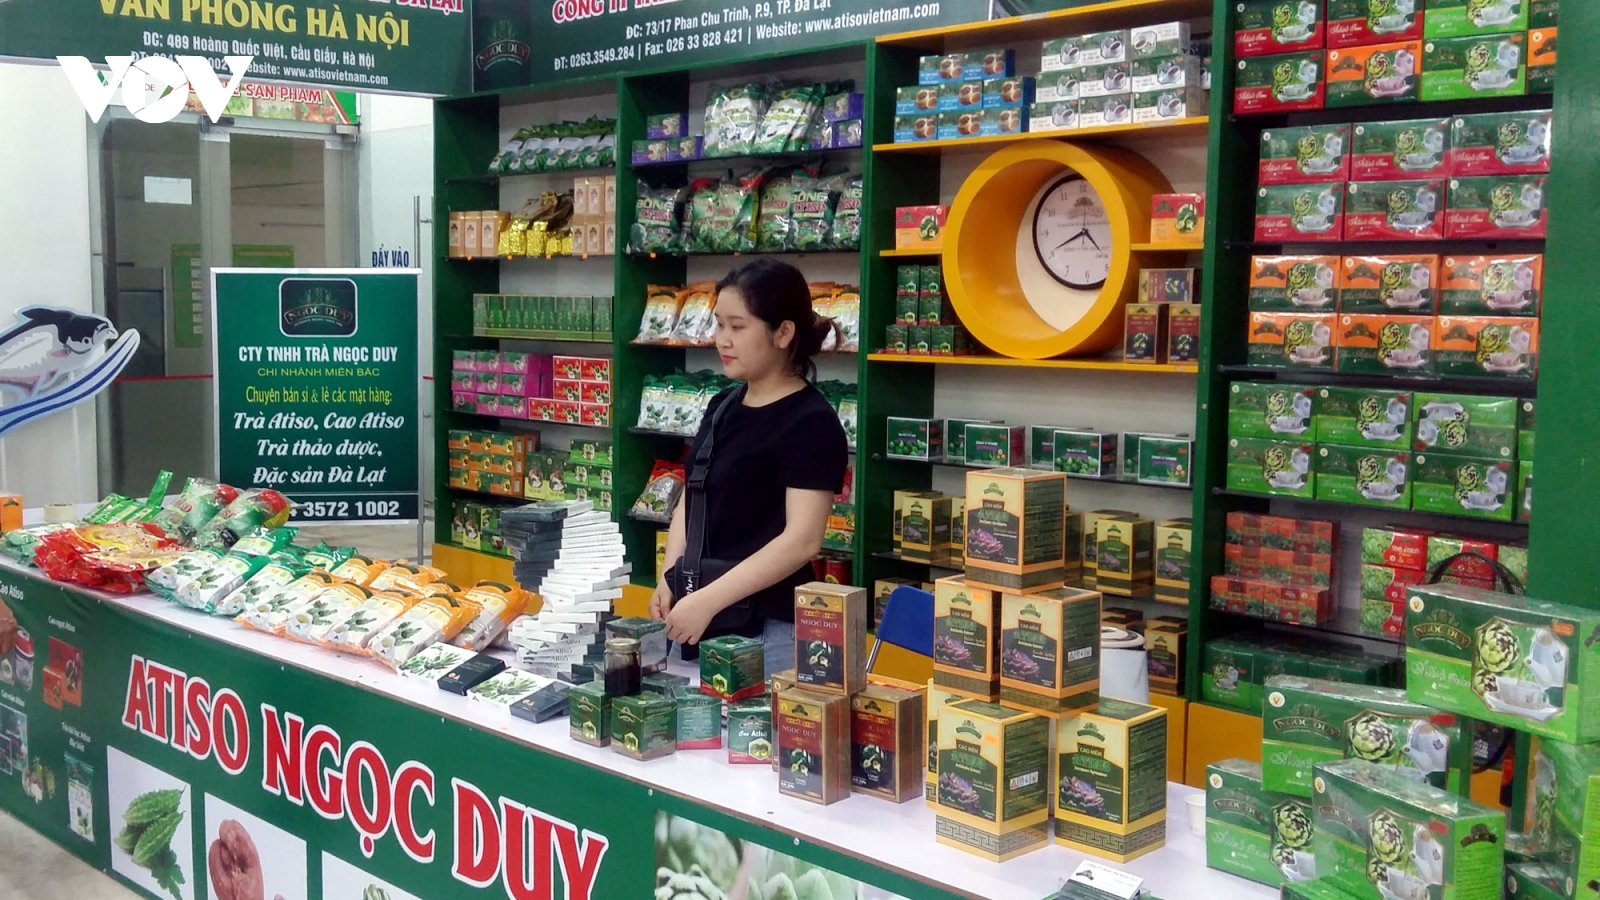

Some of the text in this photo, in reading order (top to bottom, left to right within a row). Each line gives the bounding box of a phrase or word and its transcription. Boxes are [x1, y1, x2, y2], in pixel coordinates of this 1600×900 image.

[307, 4, 349, 40] HÀ
[356, 11, 410, 50] NỘI
[626, 27, 642, 39] ĐC:
[645, 19, 671, 36] 73/17
[674, 16, 698, 32] Phan
[701, 13, 720, 27] Chu
[723, 8, 751, 23] Trinh,
[755, 3, 773, 19] P.9,
[777, 0, 791, 15] TP.
[554, 57, 568, 70] ĐT:
[570, 45, 635, 68] 0263.3549.284
[644, 42, 663, 57] Fax:
[666, 37, 684, 51] 026
[687, 35, 699, 49] 33
[702, 32, 721, 47] 828
[724, 29, 743, 45] 421
[756, 21, 802, 40] Website:
[805, 2, 940, 34] www.atisovietnam.com
[143, 31, 163, 48] ĐC:
[167, 33, 189, 49] 489
[193, 36, 229, 54] Hoàng
[232, 37, 260, 55] Quốc
[291, 43, 310, 61] Cầu
[342, 50, 356, 66] Hà
[358, 52, 375, 70] Nội
[249, 62, 281, 75] ebsite:
[283, 65, 389, 86] www.atisovietnam.com
[1048, 209, 1056, 217] 10
[372, 243, 409, 267] ĐẨY VÀO
[238, 343, 398, 365] CTY TNHH TRÀ NGỌC DUY
[257, 368, 277, 377] CHI
[246, 386, 280, 405] Chuyên
[283, 386, 299, 402] bán
[311, 389, 318, 402] &
[332, 386, 347, 402] các
[349, 387, 366, 405] mặt
[369, 386, 393, 405] hàng:
[233, 411, 405, 431] Trà Atiso, Cao Atiso
[257, 438, 383, 459] Trà thảo dược,
[253, 465, 387, 488] Đặc sản Đà Lạt
[303, 501, 349, 517] 3572
[355, 501, 400, 517] 1002
[122, 654, 609, 900] ATISO NGỌC DUY
